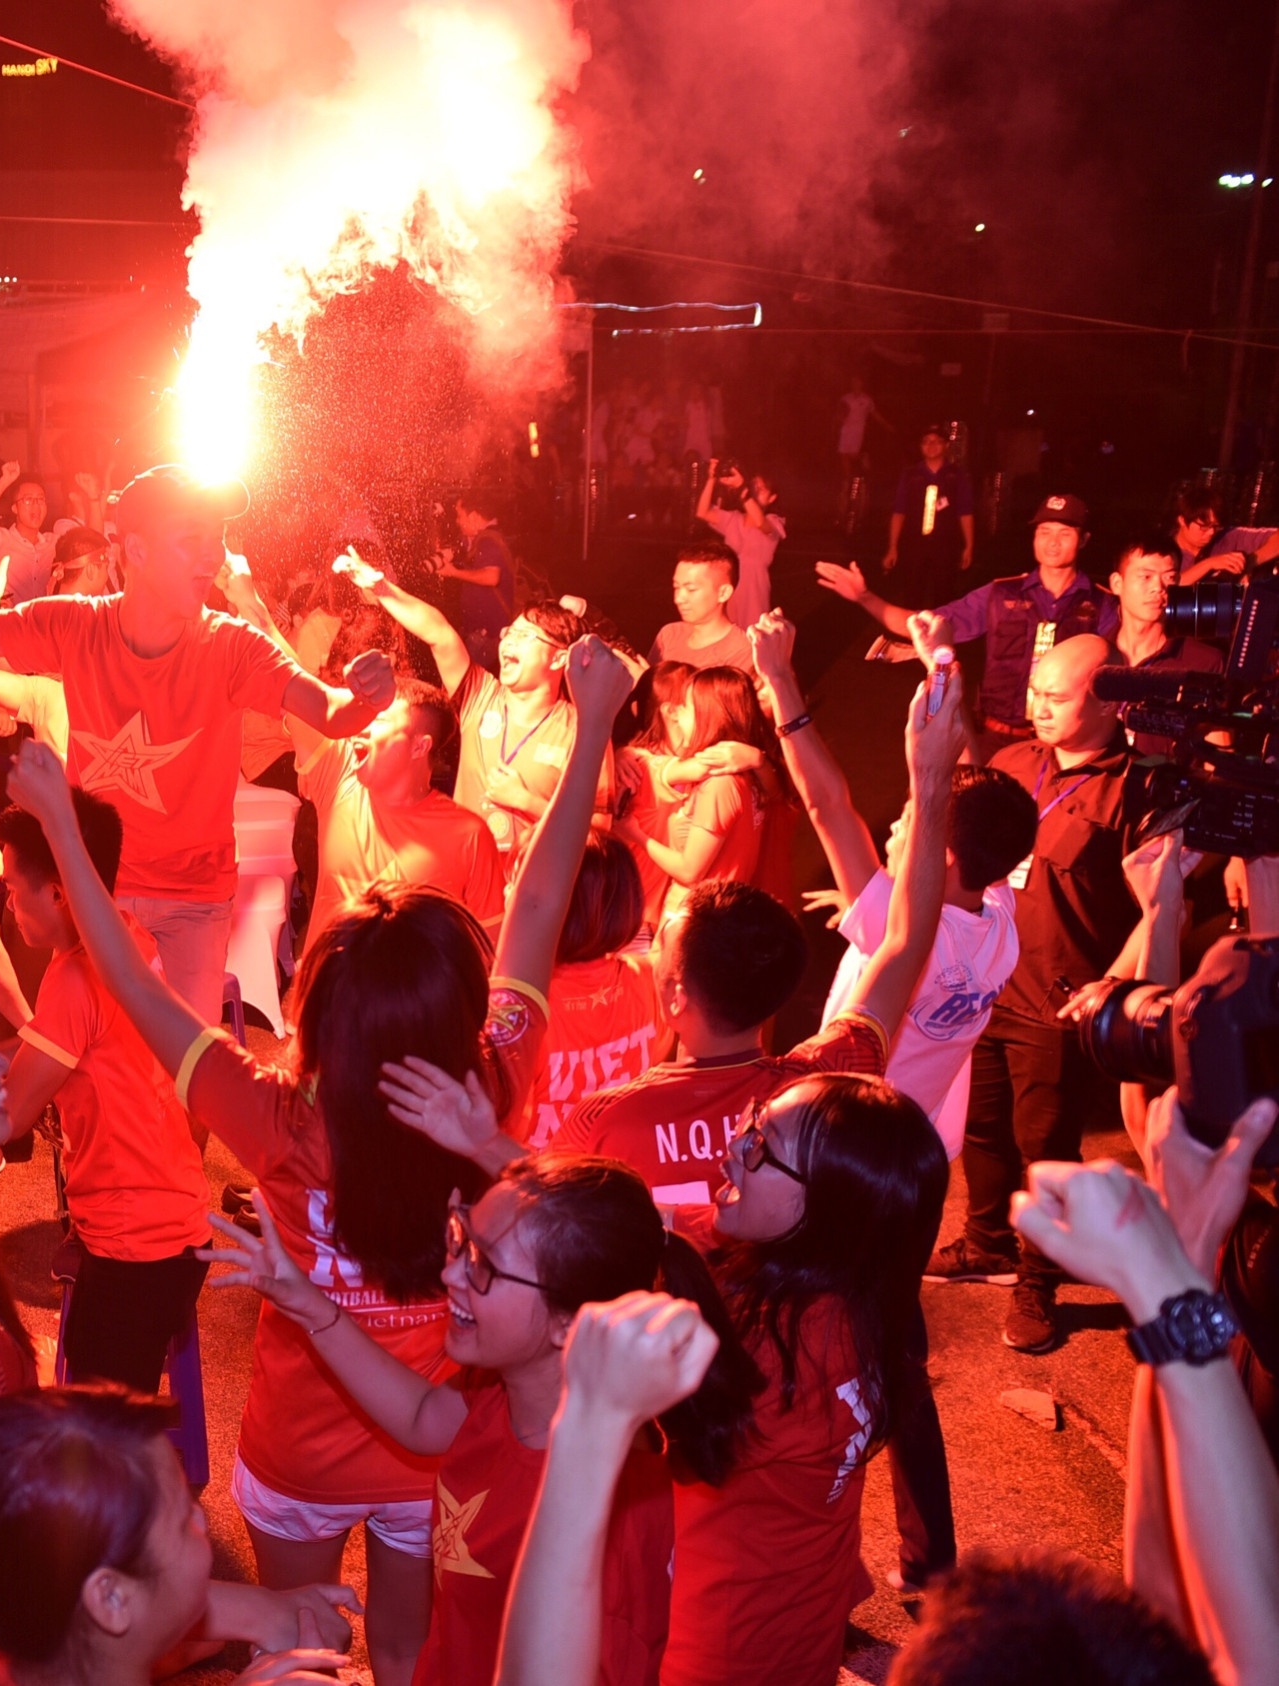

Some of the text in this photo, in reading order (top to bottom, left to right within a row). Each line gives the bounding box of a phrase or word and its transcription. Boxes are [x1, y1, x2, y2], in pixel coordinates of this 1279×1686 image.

[1, 57, 58, 76] HANOI SKY
[548, 1021, 657, 1102] VIET
